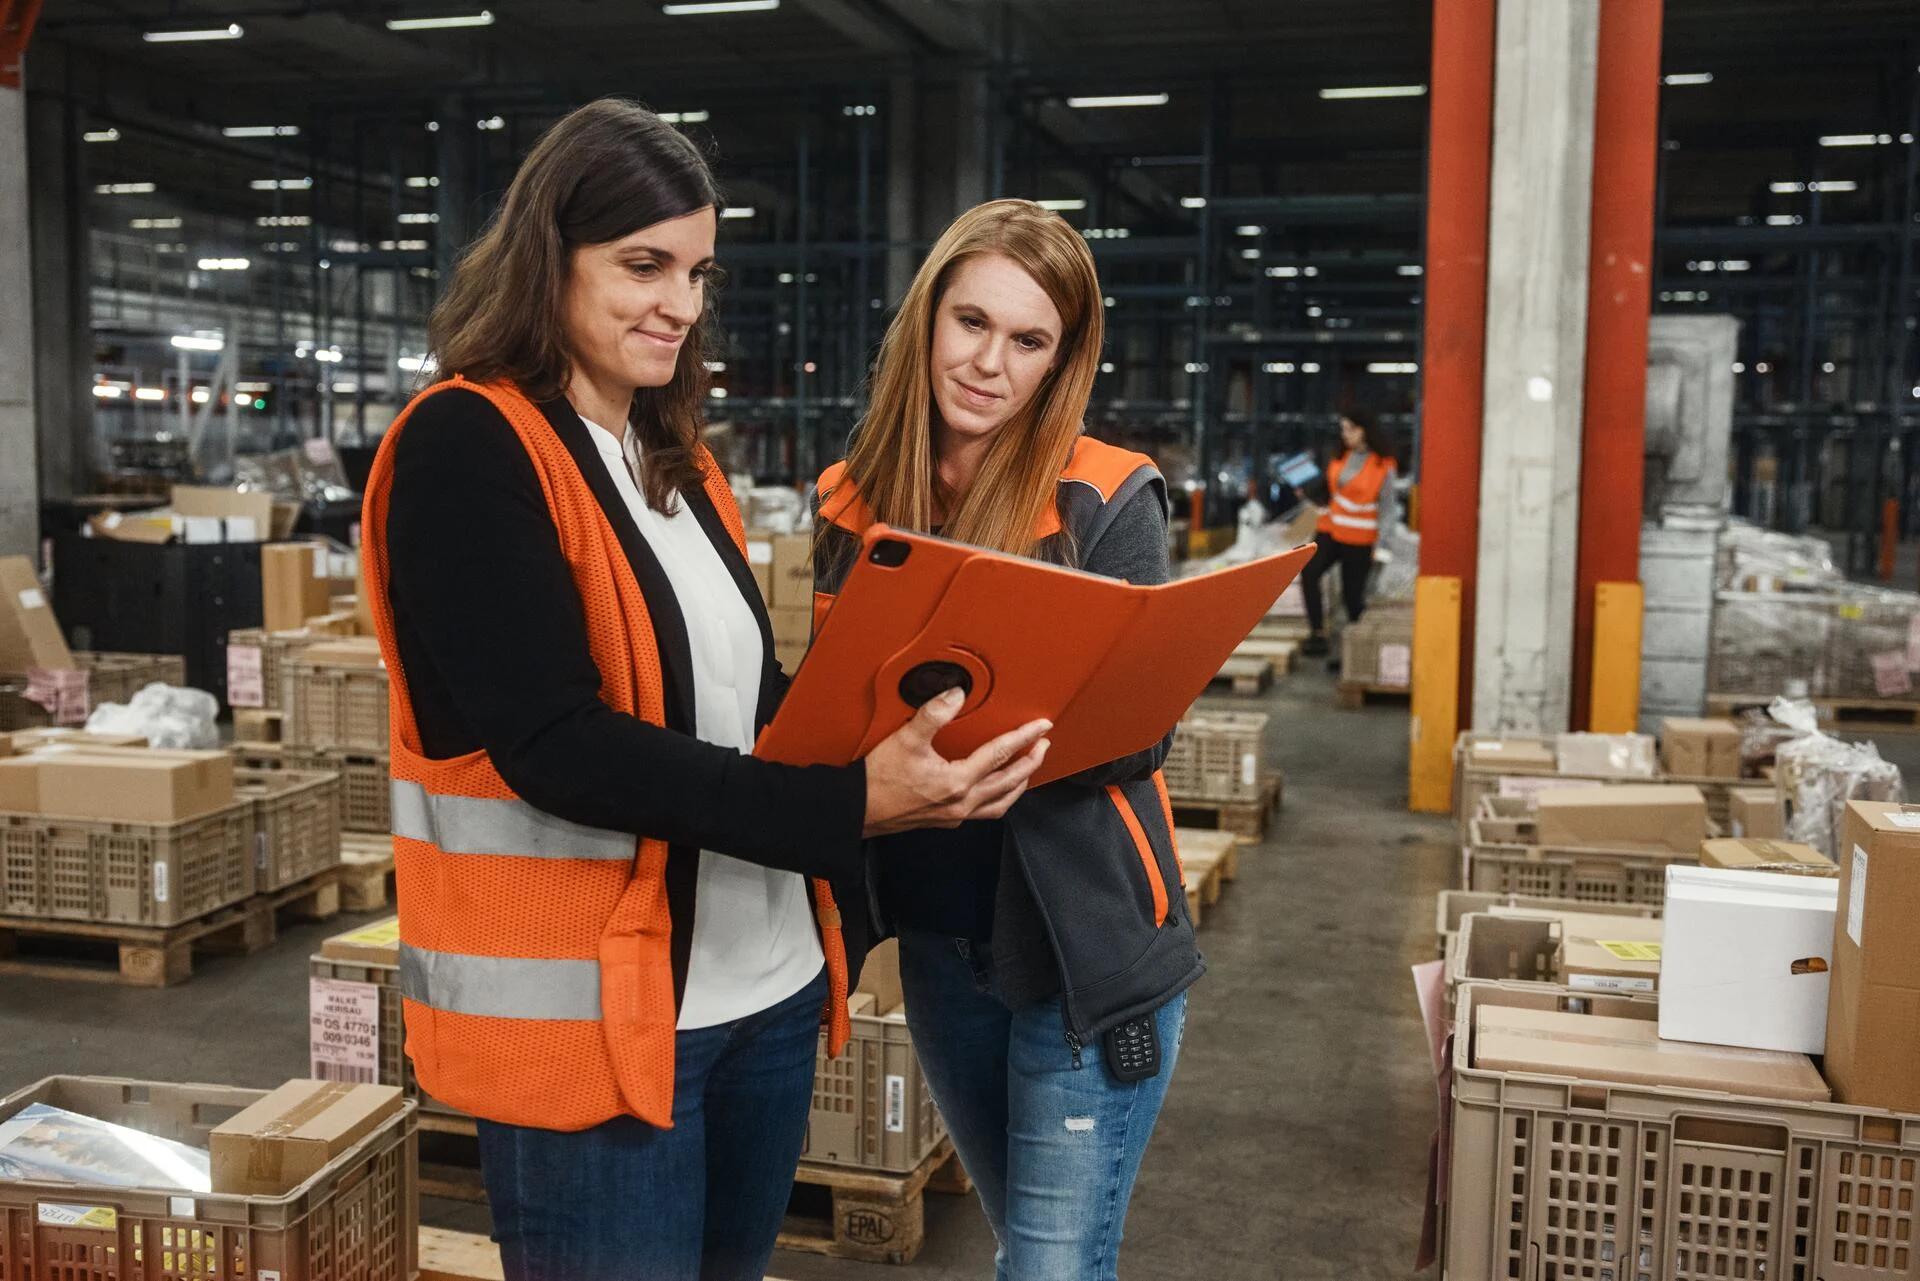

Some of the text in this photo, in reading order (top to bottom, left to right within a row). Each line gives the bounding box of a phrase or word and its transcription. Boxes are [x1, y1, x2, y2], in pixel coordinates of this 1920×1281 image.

[324, 1005, 362, 1015] HERISAU
[343, 1021, 370, 1034] 4770
[847, 1214, 888, 1241] EPAL
